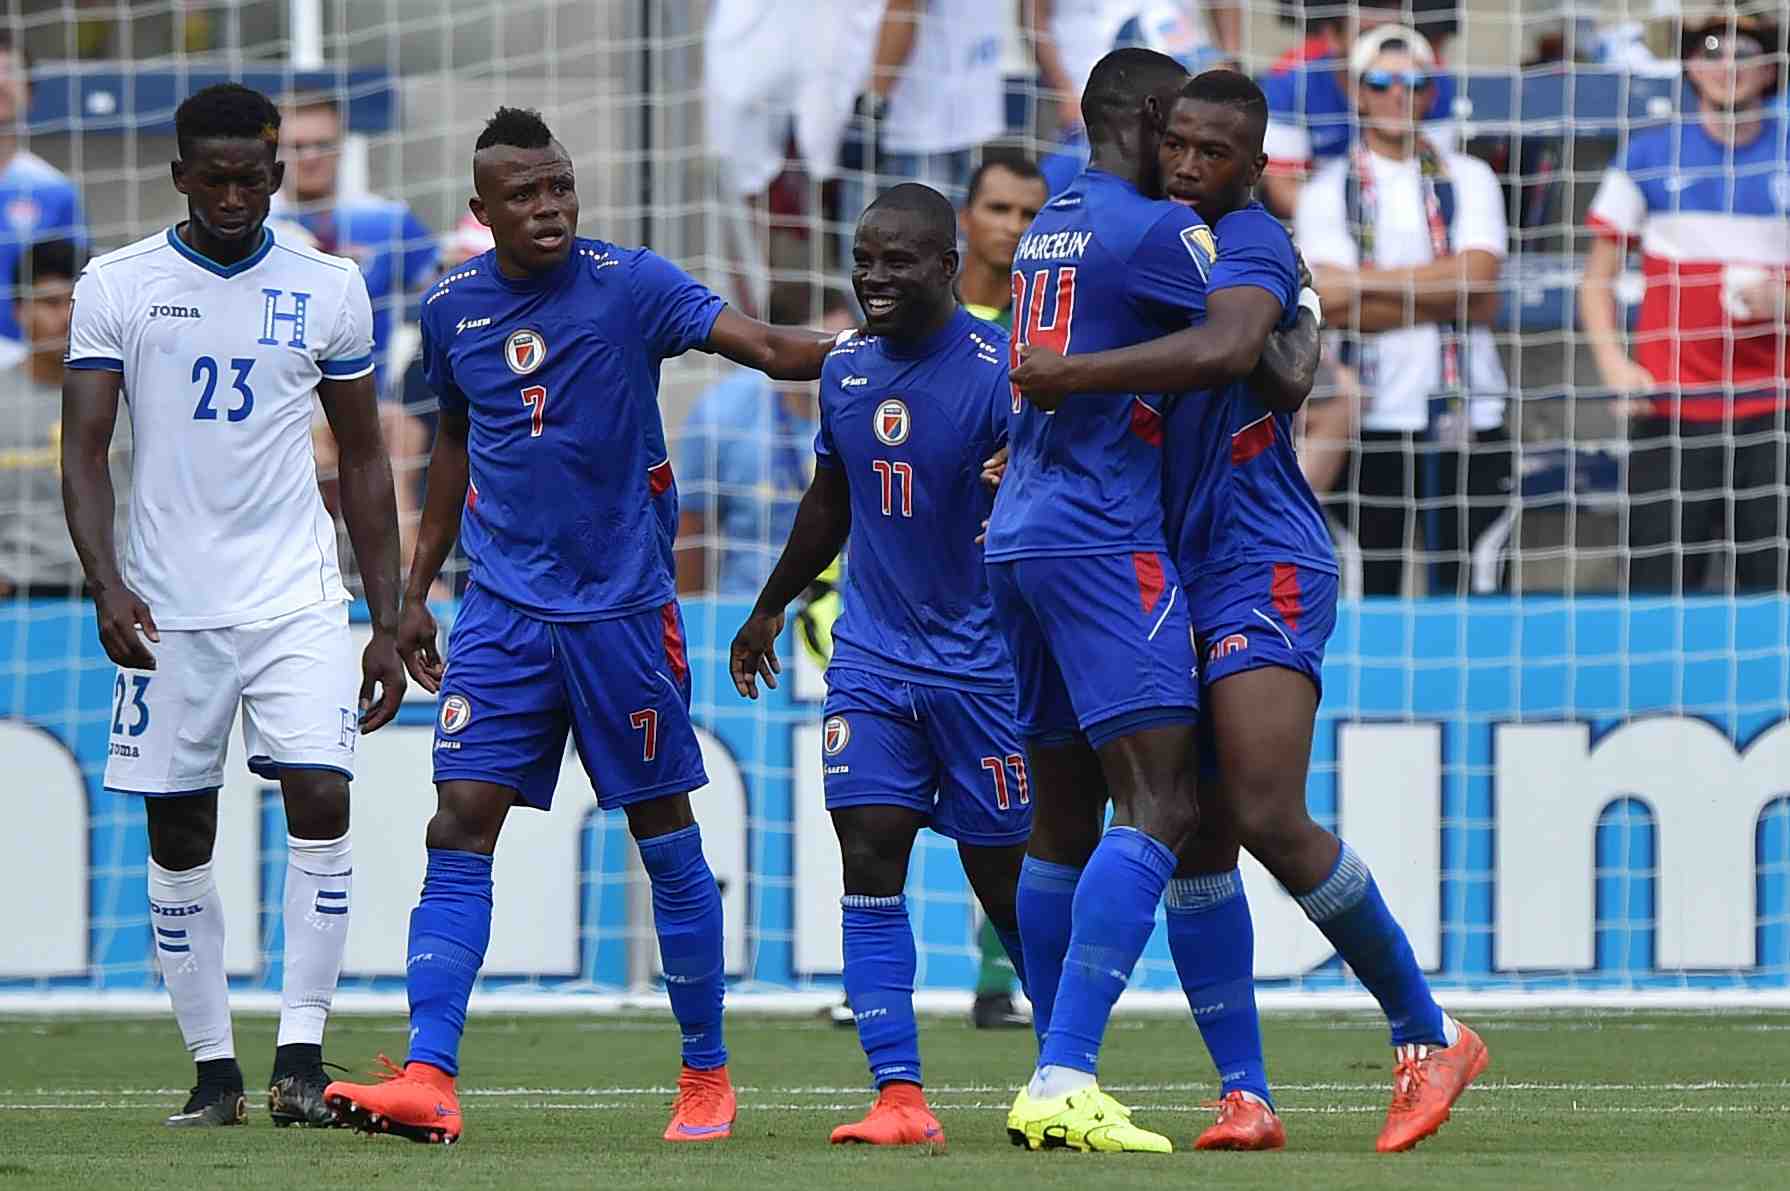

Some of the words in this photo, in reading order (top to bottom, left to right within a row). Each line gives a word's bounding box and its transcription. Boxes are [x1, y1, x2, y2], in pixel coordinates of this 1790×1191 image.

[257, 288, 311, 349] H
[191, 355, 257, 423] 23
[520, 384, 547, 438] 7
[873, 459, 912, 518] 11
[111, 671, 152, 737] 23
[629, 707, 658, 762] 7
[981, 753, 1030, 810] 11
